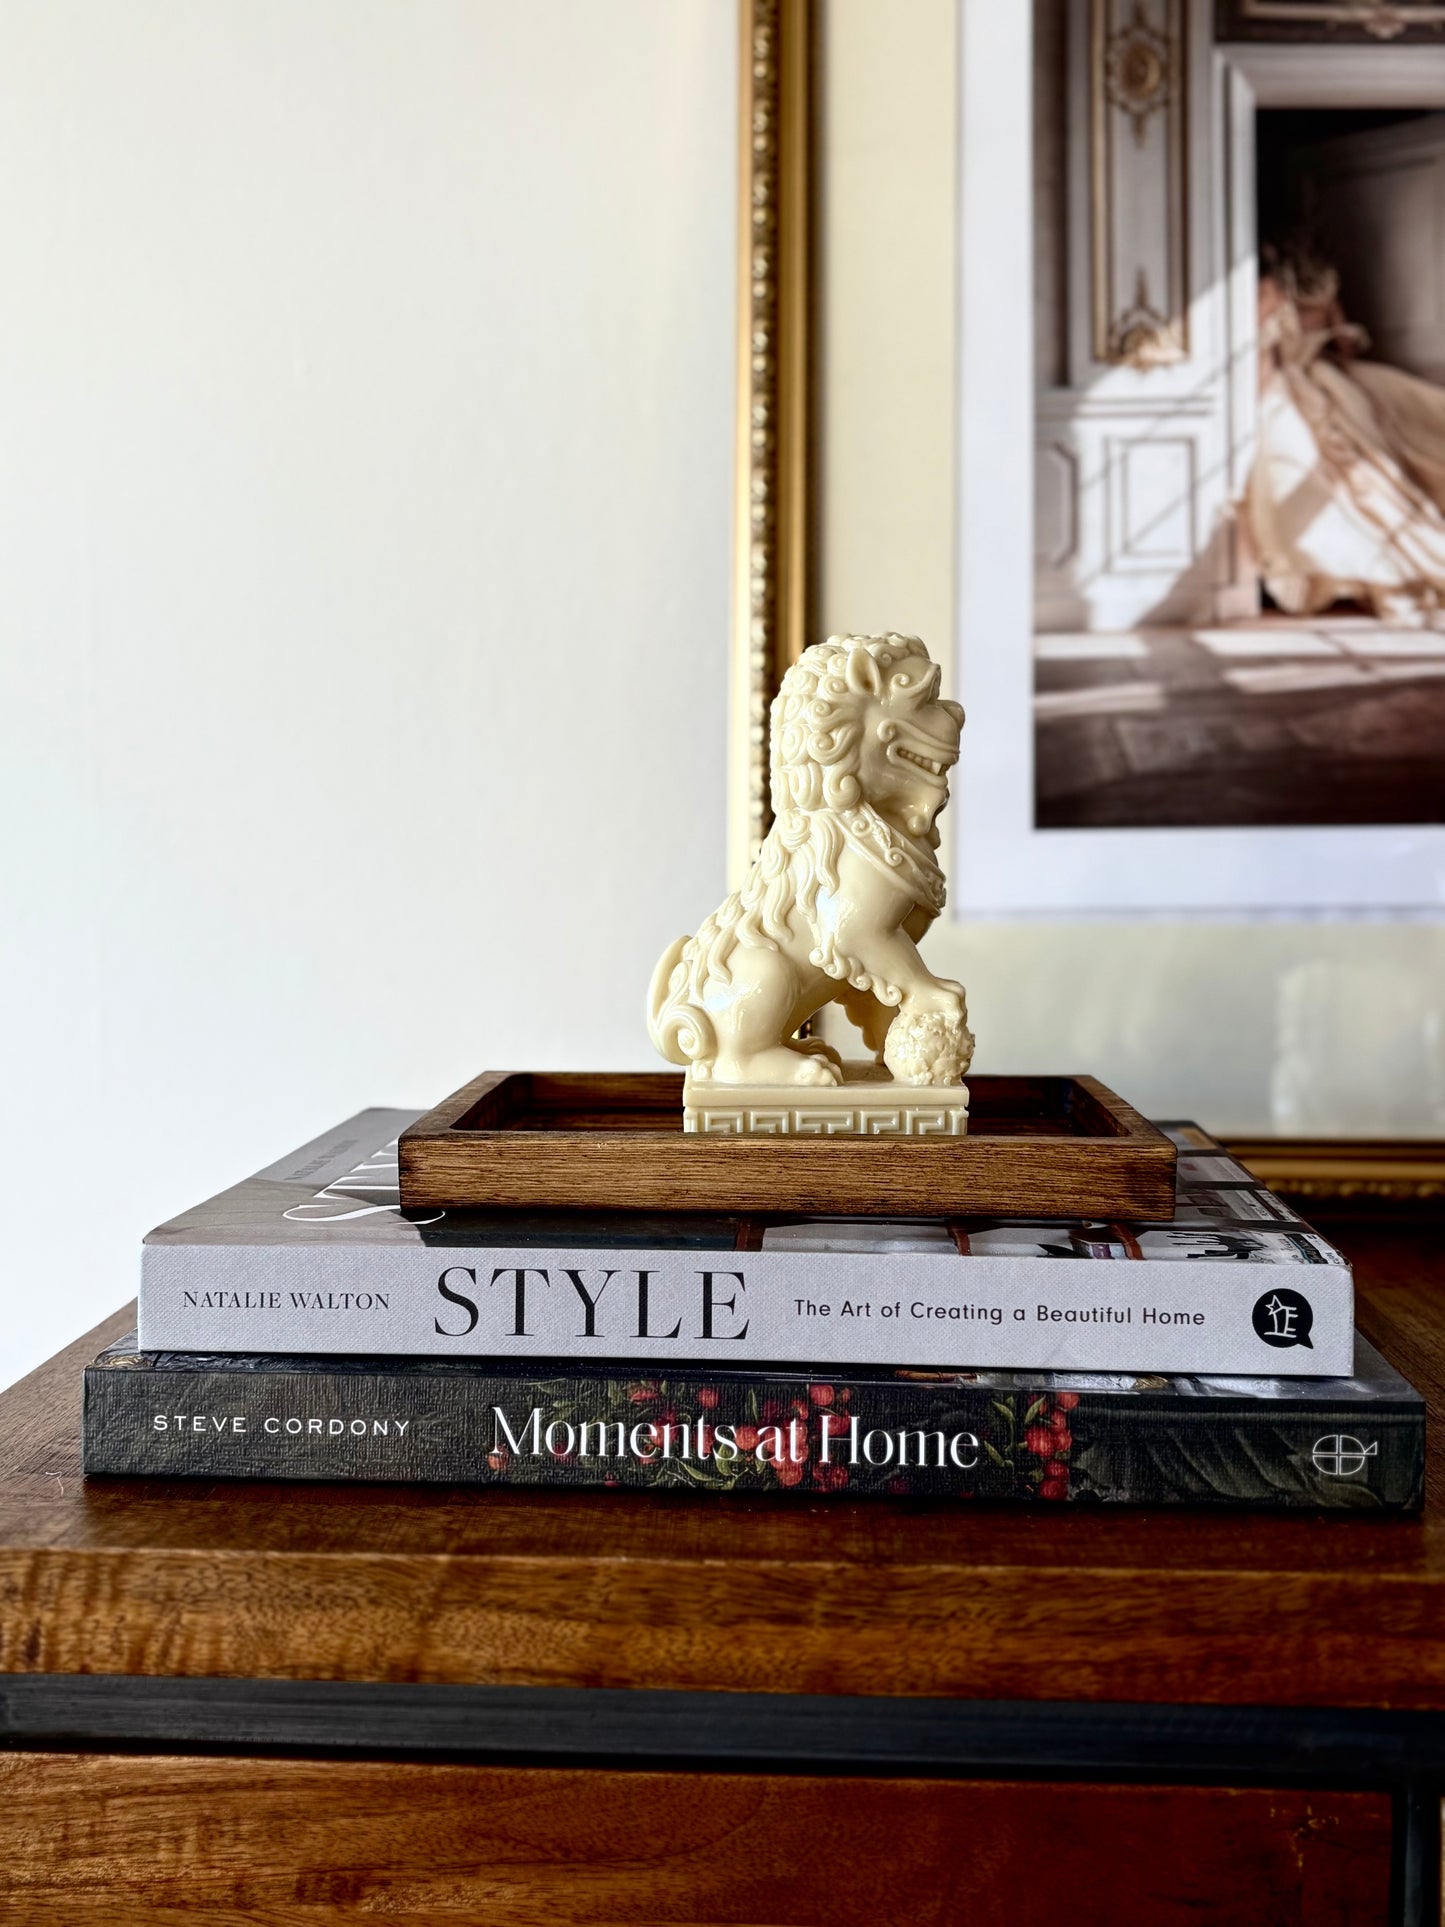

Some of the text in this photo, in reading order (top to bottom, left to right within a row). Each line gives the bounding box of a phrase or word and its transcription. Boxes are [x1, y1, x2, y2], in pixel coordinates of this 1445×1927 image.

[182, 1290, 390, 1311] NATALIE WALTON
[434, 1266, 750, 1340] STYLE
[793, 1299, 1206, 1326] The Art of Creating a Beautiful Home
[153, 1414, 409, 1437] STEVE CORDONY
[491, 1406, 979, 1468] Moments at Home
